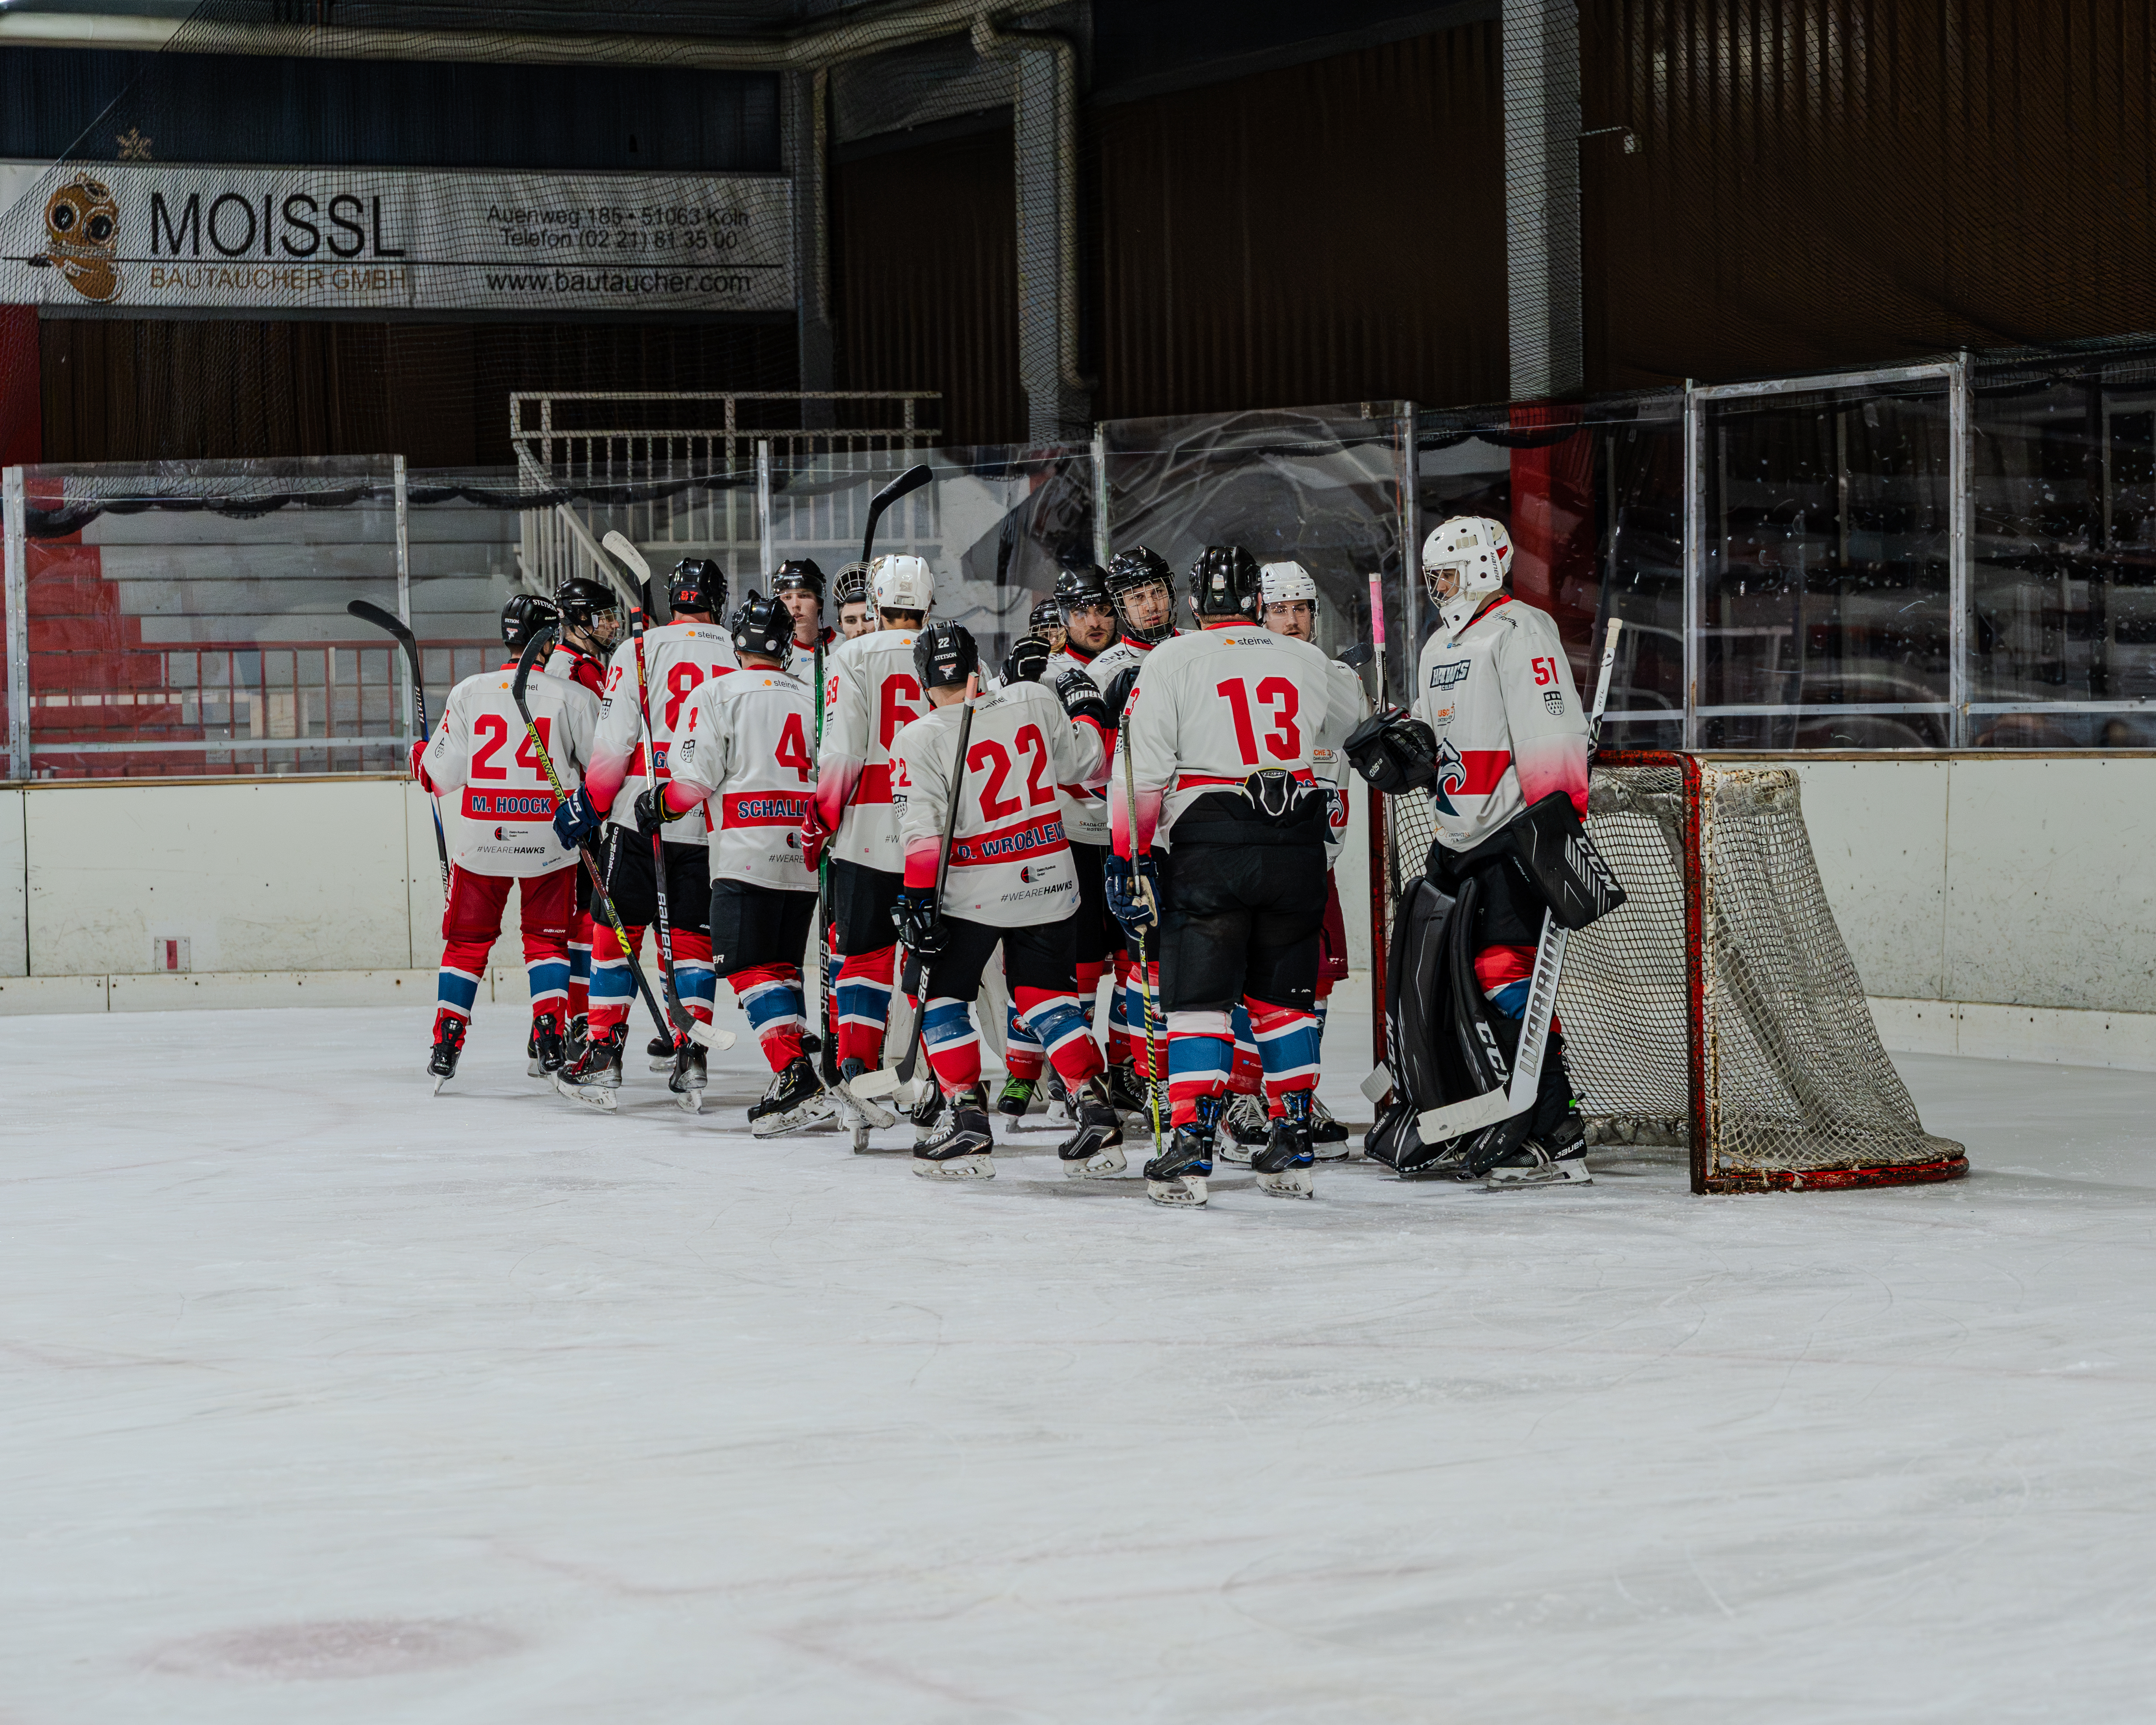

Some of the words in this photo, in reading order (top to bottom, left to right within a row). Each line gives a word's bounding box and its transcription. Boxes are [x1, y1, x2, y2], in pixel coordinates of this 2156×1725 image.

[151, 192, 404, 257] MOISSL
[487, 206, 580, 229] Auerweg
[500, 228, 571, 246] Telefon
[152, 267, 324, 290] BAUTAUCHER
[332, 269, 405, 290] GMBH
[486, 271, 752, 294] www.bautaucher.com
[1490, 552, 1500, 581] BAUER
[680, 590, 698, 602] 87
[698, 631, 725, 643] steinel
[938, 637, 949, 649] 22
[1237, 637, 1274, 646] steinel
[934, 652, 958, 661] STETSON
[1531, 657, 1559, 686] 51
[774, 679, 800, 691] steinel
[826, 675, 840, 708] 69
[415, 686, 425, 724] FLYLITE
[880, 673, 921, 753] 6
[688, 707, 698, 732] 4
[1216, 676, 1301, 766] 13
[471, 714, 554, 781] 24
[775, 713, 813, 783] 4
[966, 723, 1056, 823] 22
[472, 796, 491, 813] M.
[496, 796, 552, 814] HOOCK
[738, 799, 809, 819] SCHALL
[477, 846, 545, 854] #WEAREHAWKS
[768, 854, 806, 864] #WEARE
[1576, 835, 1619, 891] CCM
[1001, 880, 1073, 903] #WEAREHAWKS
[657, 892, 673, 961] BAUER
[820, 939, 829, 1015] BAUER
[1519, 913, 1563, 1078] WARRIOR
[1555, 1138, 1584, 1159] BAUER
